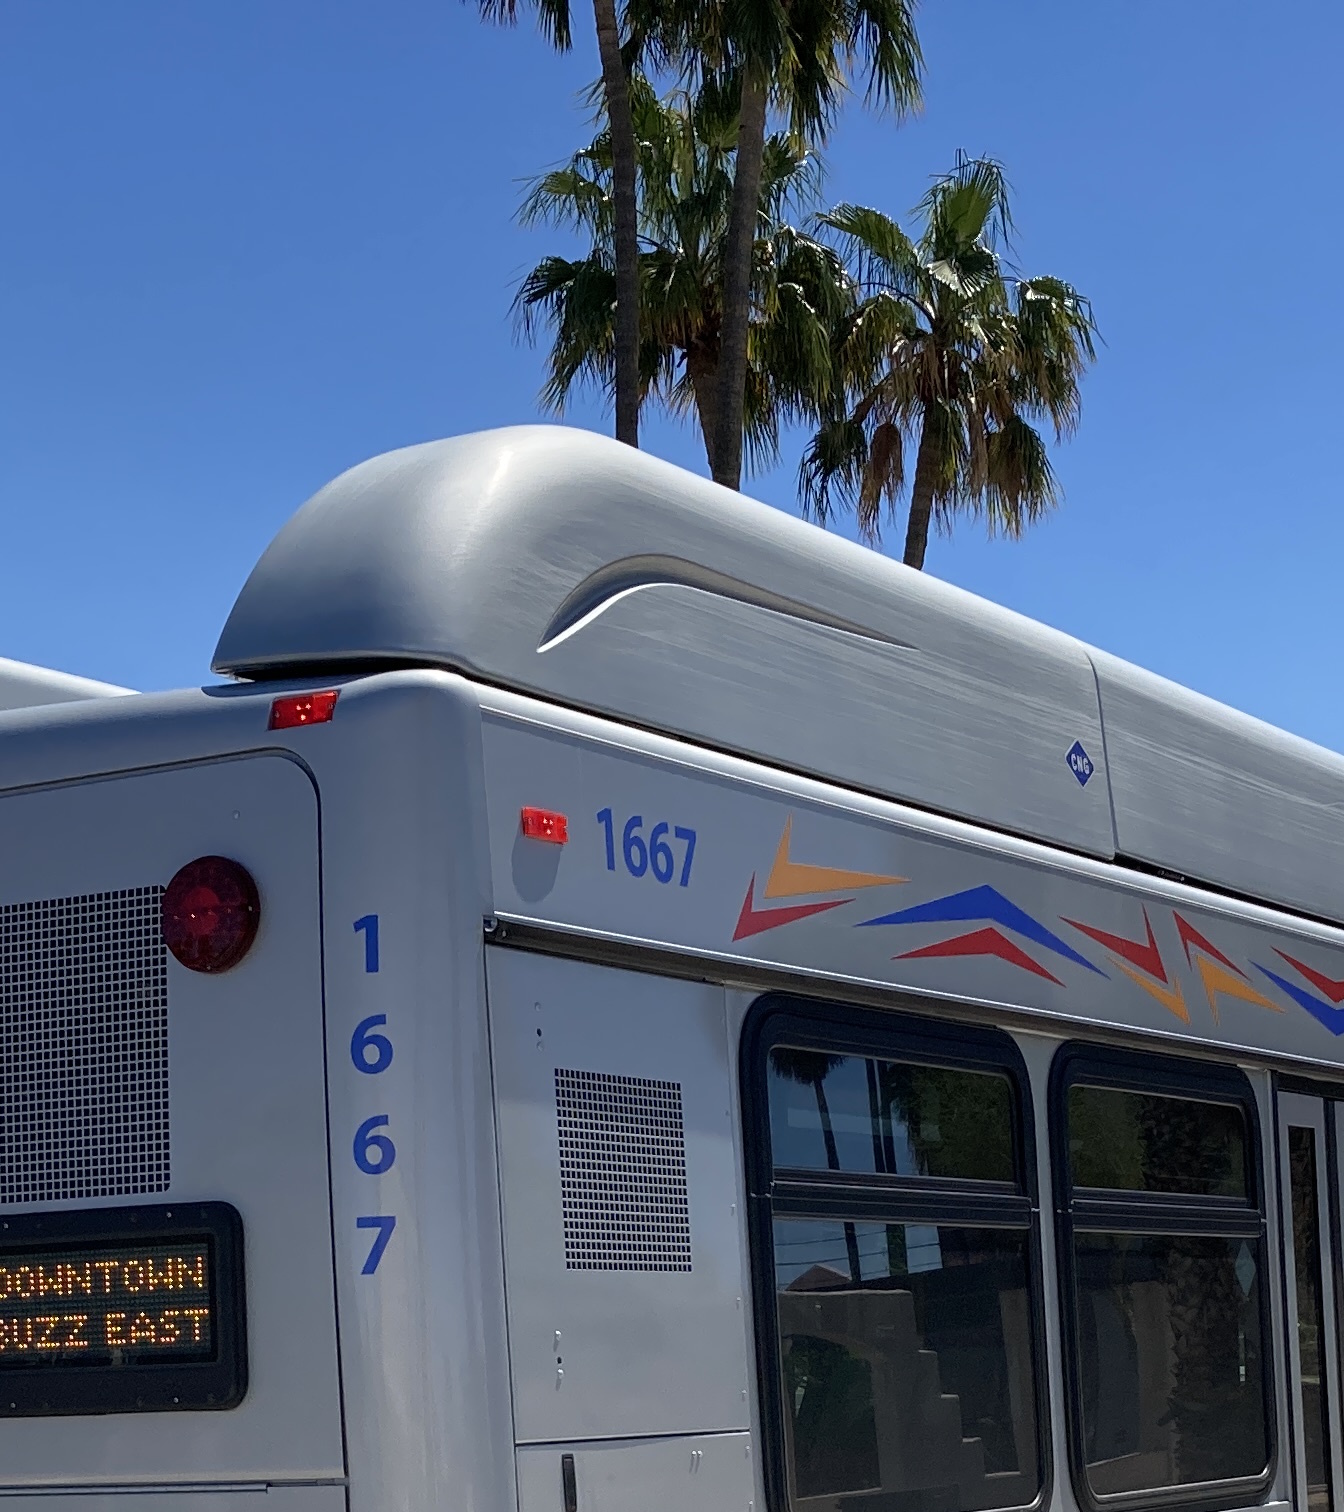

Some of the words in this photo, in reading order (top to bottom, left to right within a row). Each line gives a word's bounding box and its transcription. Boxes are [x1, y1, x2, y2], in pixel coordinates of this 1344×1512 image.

[1070, 753, 1090, 775] CNG
[596, 808, 697, 888] 1667
[106, 1308, 209, 1345] EAST
